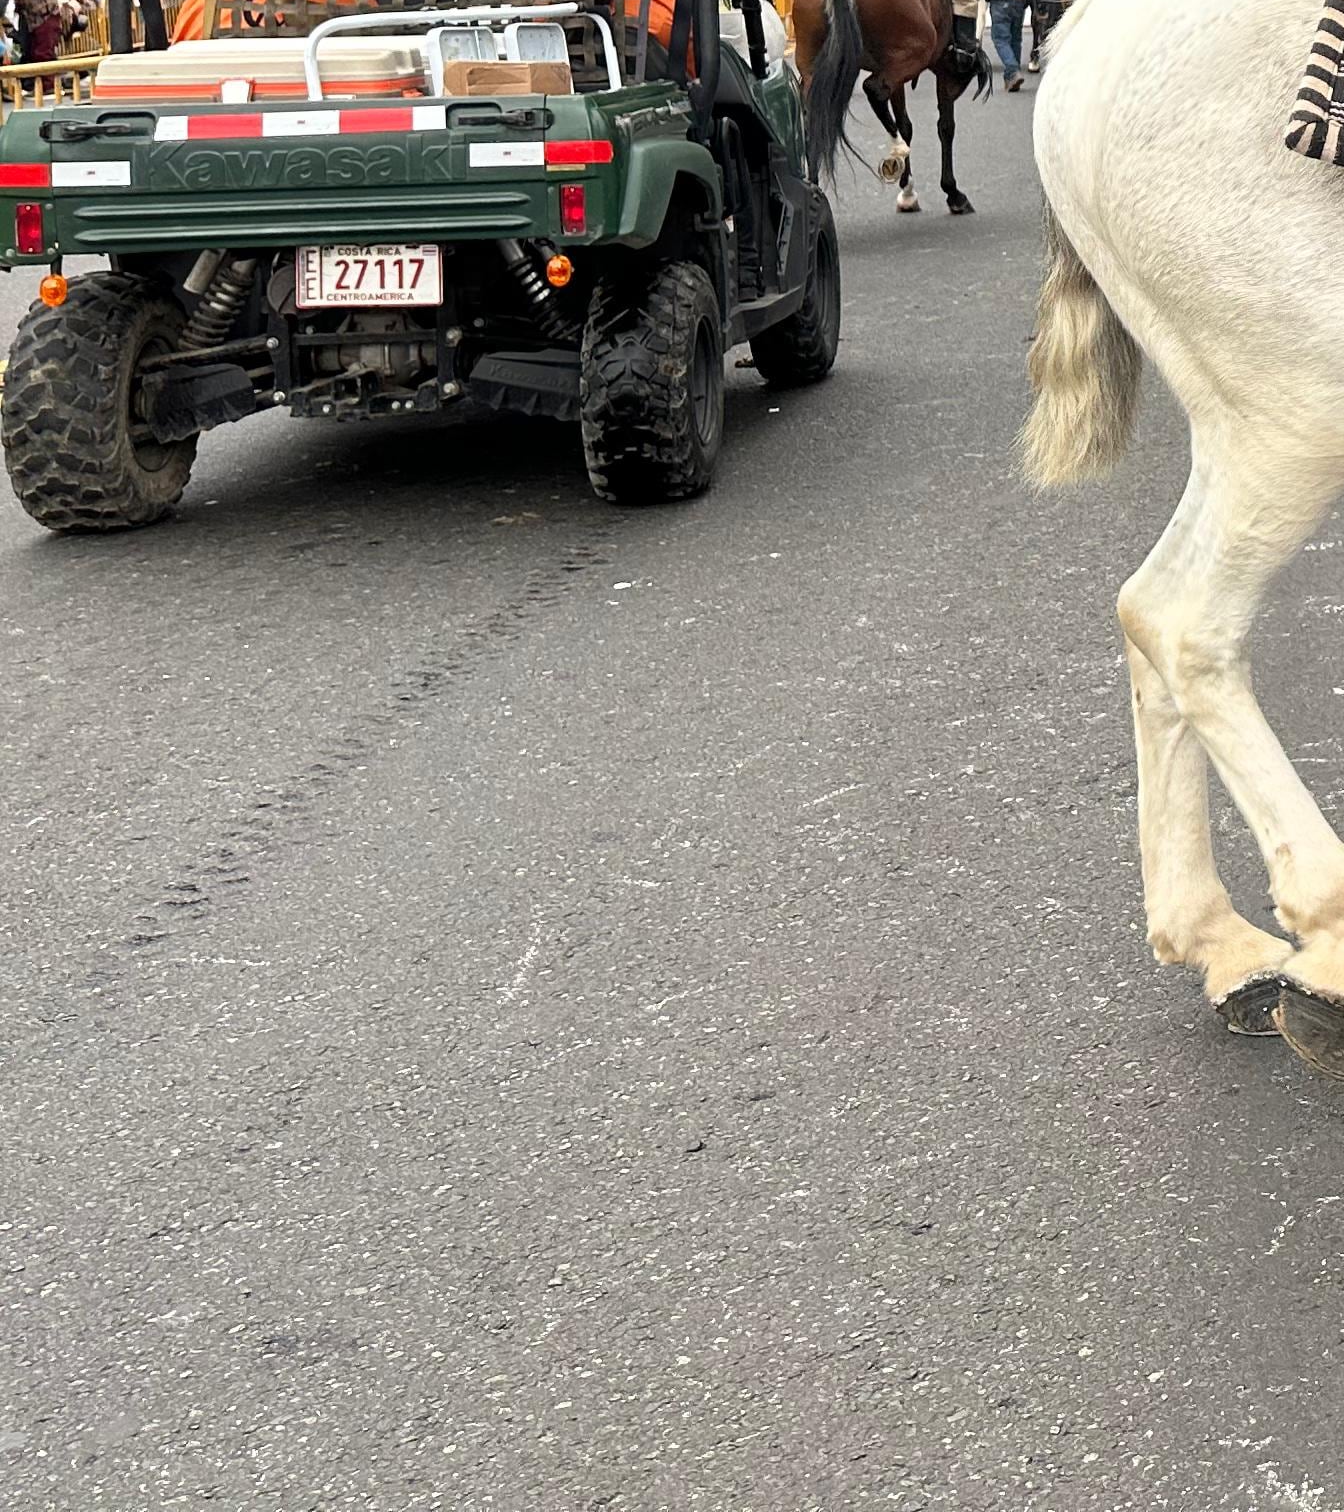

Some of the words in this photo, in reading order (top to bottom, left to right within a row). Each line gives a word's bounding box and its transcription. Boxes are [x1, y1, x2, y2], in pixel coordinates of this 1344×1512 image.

[144, 133, 468, 189] Kawasaki
[337, 246, 373, 256] COSTA
[377, 247, 401, 256] RICA
[334, 258, 425, 290] 27117
[326, 292, 414, 302] CENTROAMERICA
